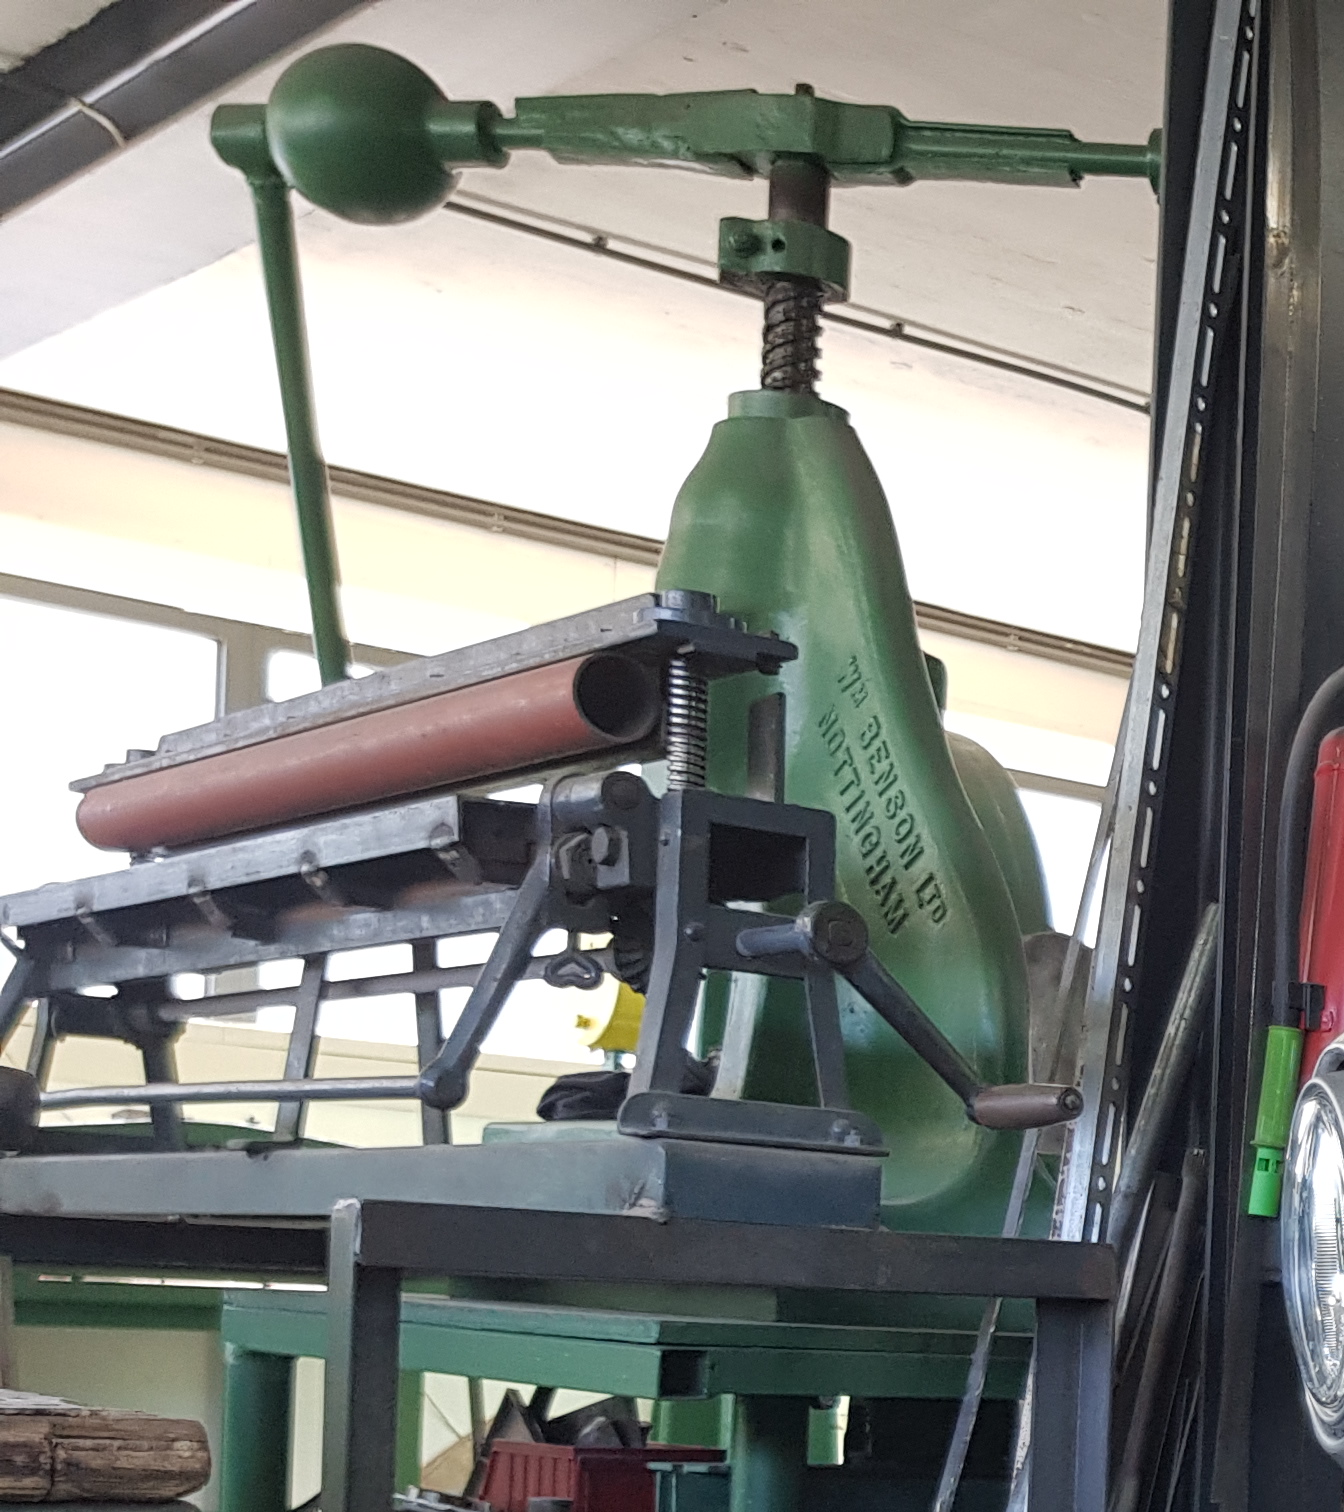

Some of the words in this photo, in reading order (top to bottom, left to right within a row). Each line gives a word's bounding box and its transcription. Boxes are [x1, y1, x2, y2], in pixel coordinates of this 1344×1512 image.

[818, 703, 910, 935] NOTTINGHAM
[860, 715, 925, 871] BENSON
[916, 872, 948, 924] LTD
